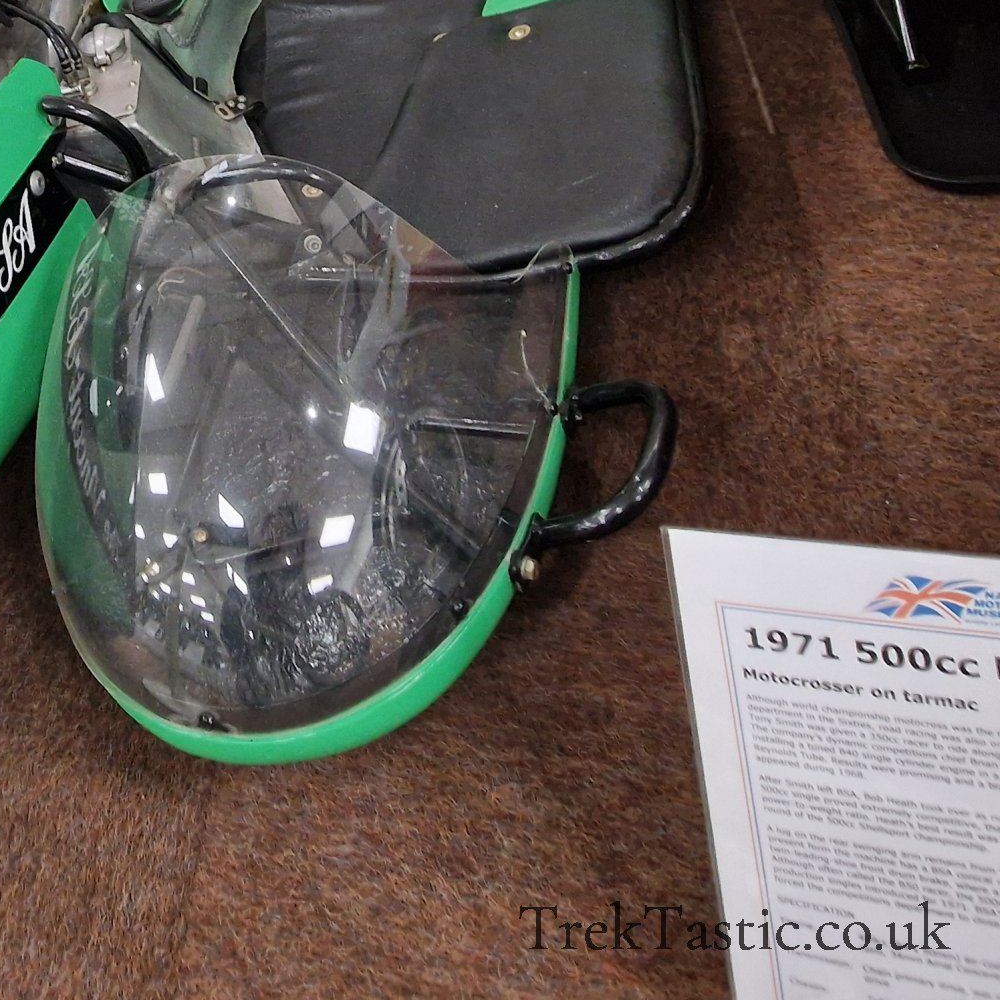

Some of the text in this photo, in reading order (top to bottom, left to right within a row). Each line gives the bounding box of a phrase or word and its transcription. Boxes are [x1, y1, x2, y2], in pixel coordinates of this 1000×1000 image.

[744, 626, 840, 660] 1971
[855, 639, 980, 678] 500cc
[743, 666, 979, 712] Motocrosser on tarmac
